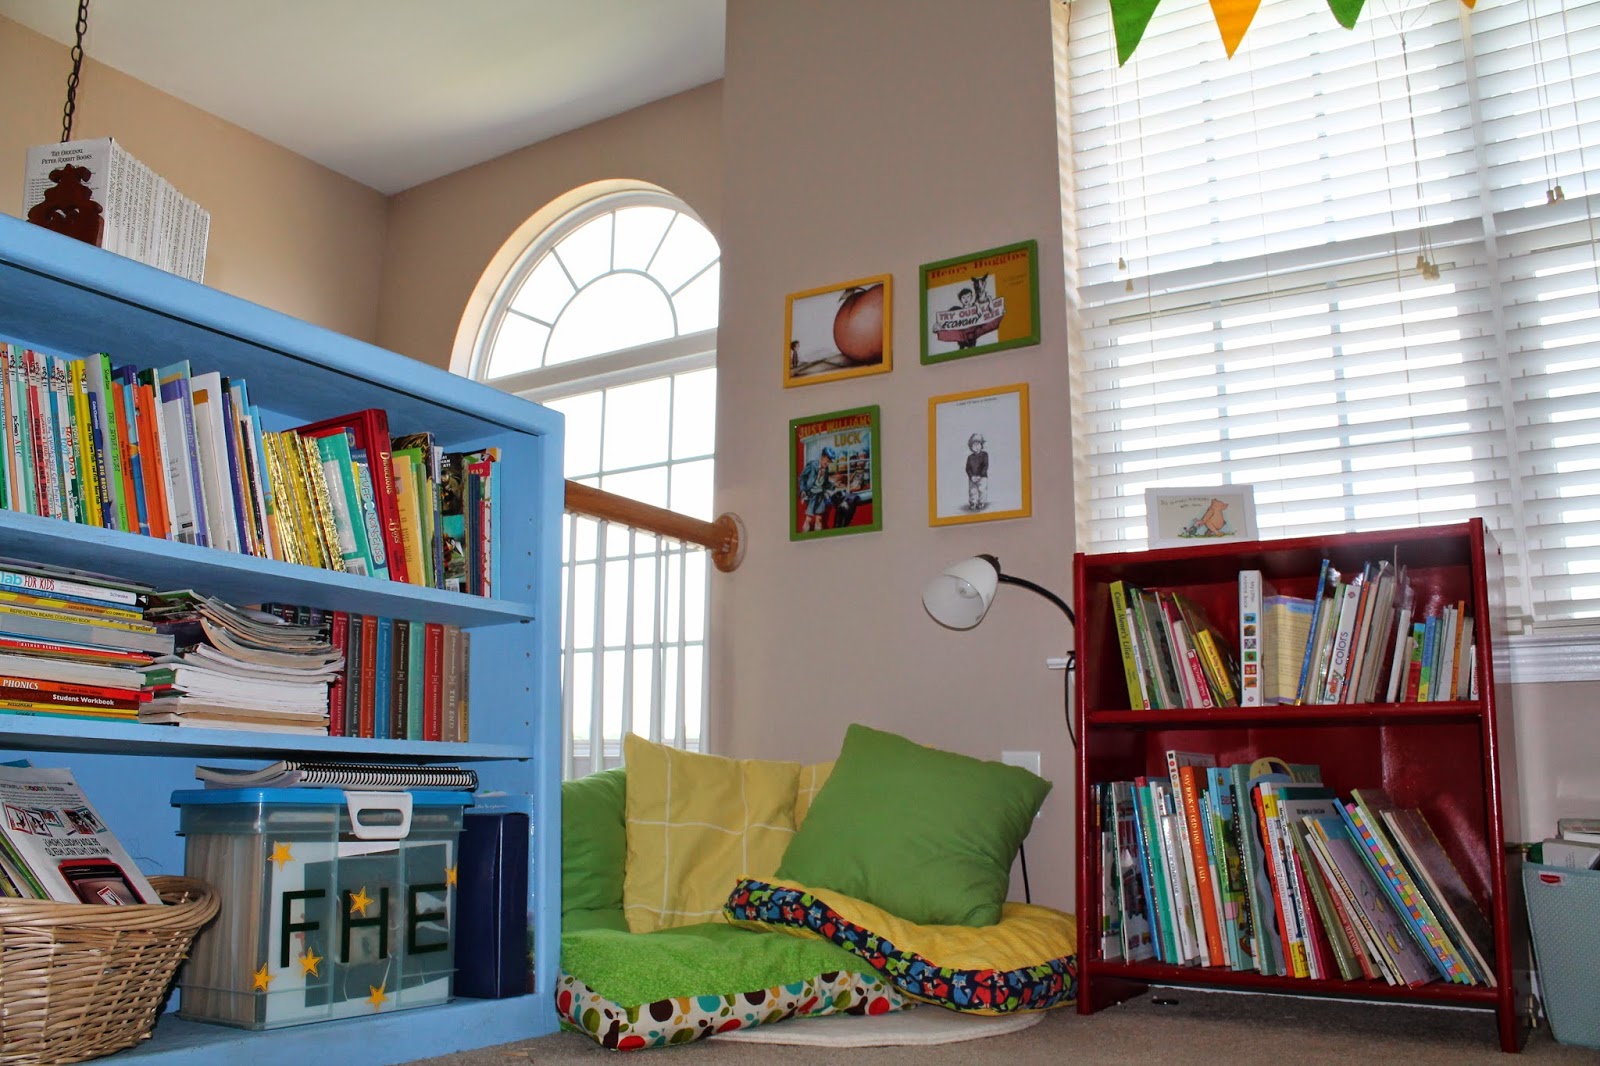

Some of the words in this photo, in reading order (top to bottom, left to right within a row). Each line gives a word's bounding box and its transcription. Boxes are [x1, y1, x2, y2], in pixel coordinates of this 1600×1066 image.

[57, 155, 75, 163] RABBIT
[974, 252, 1026, 269] Huggins
[939, 312, 955, 320] TRY
[959, 310, 976, 318] OUR
[942, 317, 980, 330] ECONOMY
[984, 309, 1000, 320] SIZE
[65, 426, 73, 446] HOP
[799, 424, 823, 438] JUST
[834, 432, 861, 447] LUCK
[13, 438, 23, 458] ABC
[68, 456, 76, 475] POP
[358, 469, 371, 500] STUFF
[366, 511, 383, 562] NONSENSE
[0, 571, 23, 585] lab
[23, 575, 37, 588] FOR
[38, 577, 55, 590] KIDS
[1114, 591, 1123, 610] Count
[1117, 612, 1128, 638] Monet's
[1122, 640, 1131, 659] Lilies
[1332, 630, 1350, 665] colors
[2, 679, 39, 690] PHONICS
[1323, 669, 1343, 703] baby
[52, 694, 79, 702] Student
[80, 696, 114, 705] Workbook
[1183, 774, 1190, 786] MY
[1173, 790, 1180, 798] my
[1332, 868, 1344, 883] LLAMA
[1342, 883, 1353, 899] LLAMA
[1361, 915, 1372, 930] MAMA
[281, 883, 448, 968] FHE
